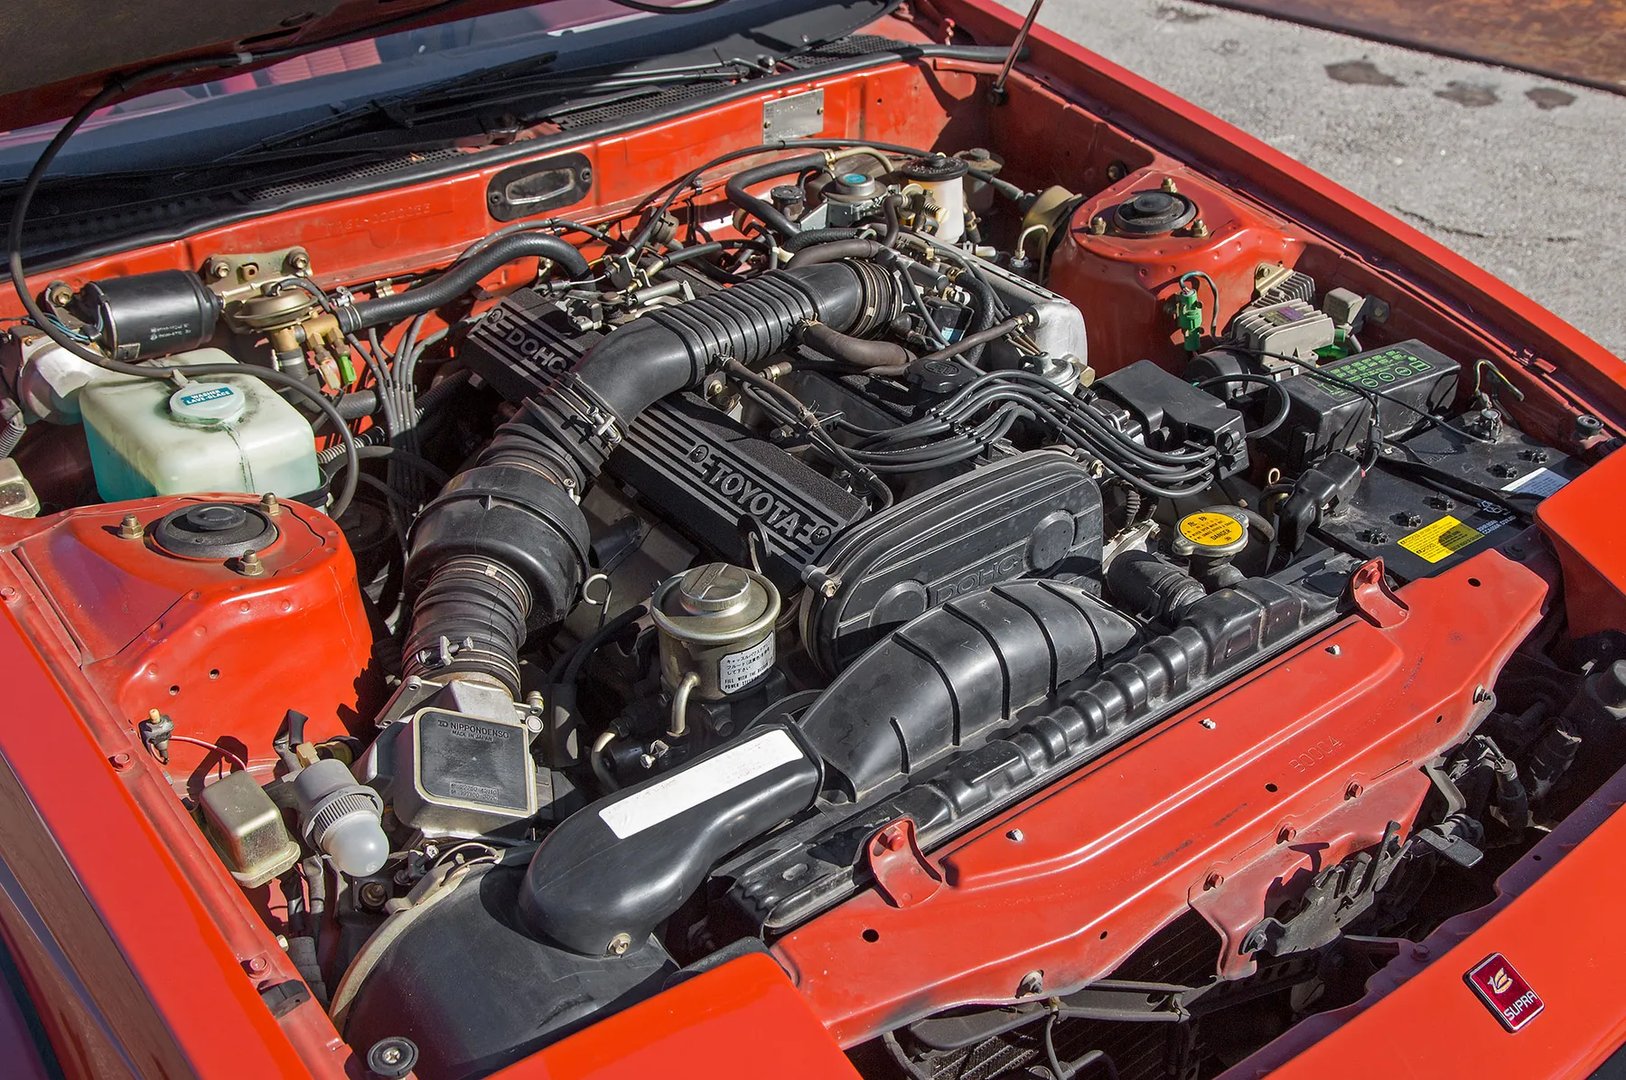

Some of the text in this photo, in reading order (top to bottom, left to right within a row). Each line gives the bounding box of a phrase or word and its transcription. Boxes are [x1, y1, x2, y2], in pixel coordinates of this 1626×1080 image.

[505, 328, 567, 375] DOHC
[191, 389, 221, 399] WASHER
[709, 462, 801, 538] TOYOTA
[1210, 529, 1231, 540] DANGER
[934, 553, 1019, 604] DOHC
[450, 722, 509, 738] NIPPONDENSO
[475, 734, 493, 742] JAPAN
[1504, 990, 1538, 1021] SUPRA
